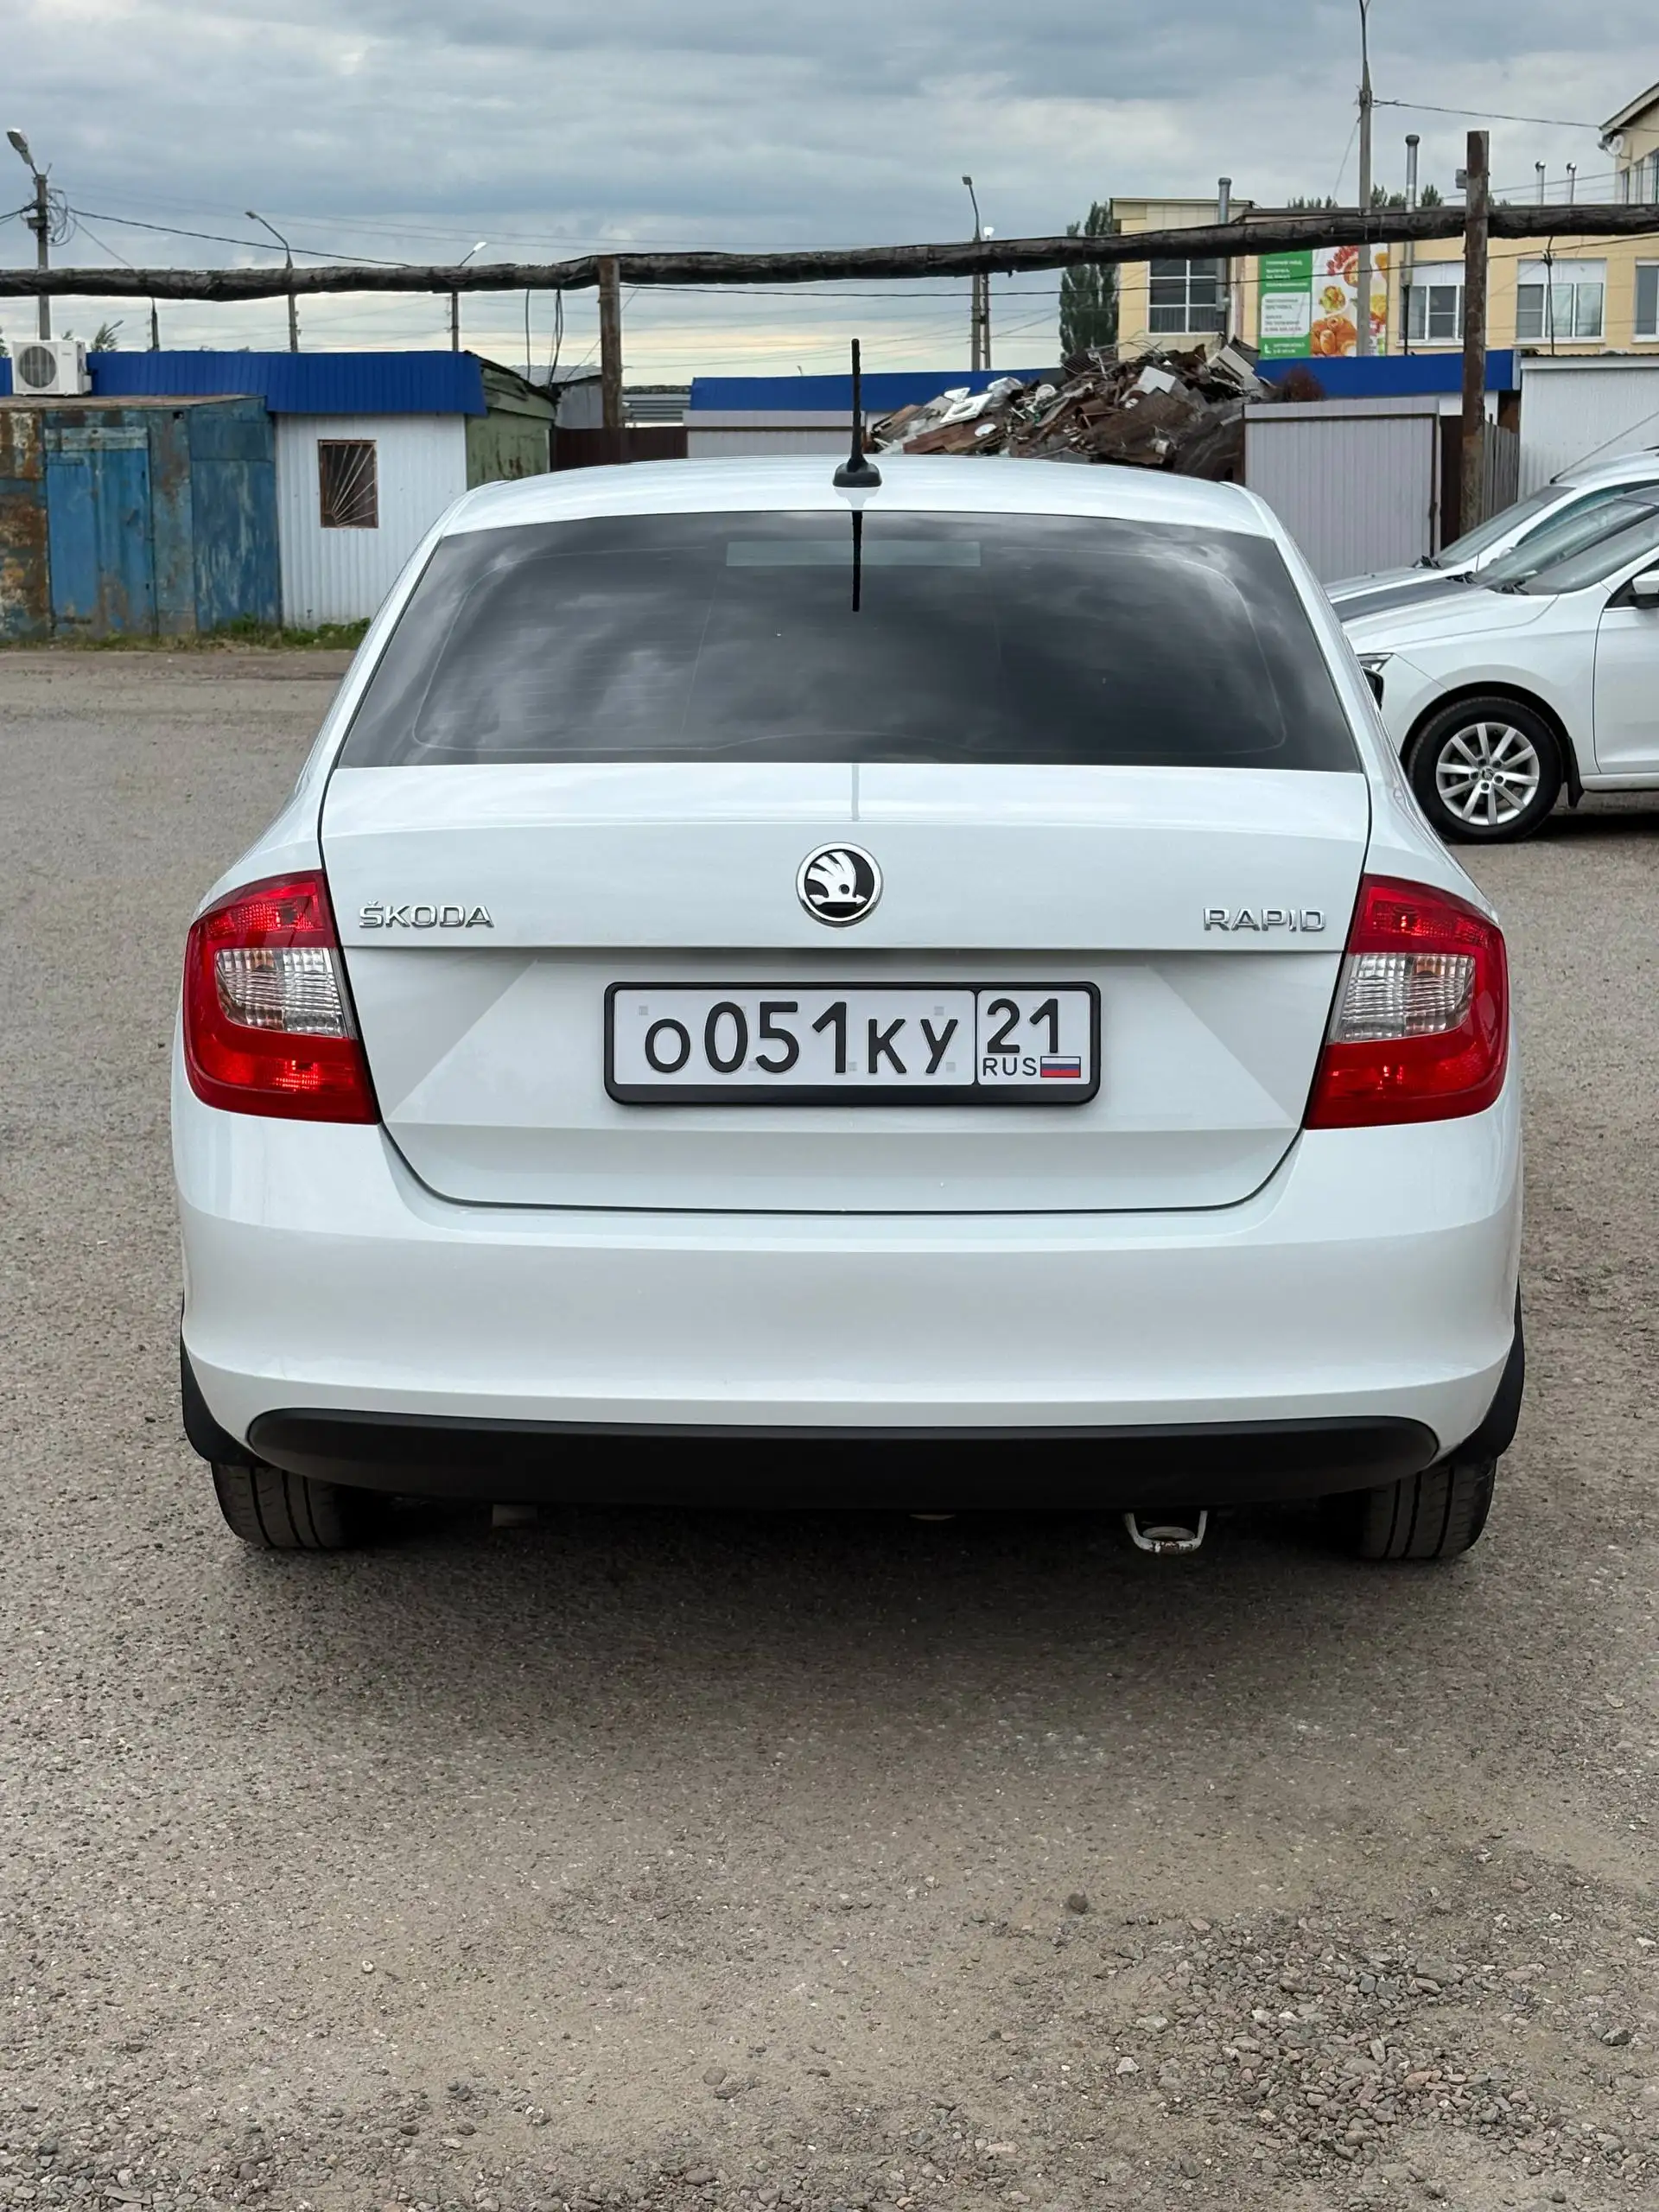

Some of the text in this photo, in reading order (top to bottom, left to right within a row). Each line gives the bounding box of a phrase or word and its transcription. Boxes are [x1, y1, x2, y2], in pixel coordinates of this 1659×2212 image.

[359, 899, 494, 928] ŠKODA
[1203, 907, 1326, 931] RAPID
[986, 997, 1058, 1053] 21
[982, 1057, 1037, 1077] RUS
